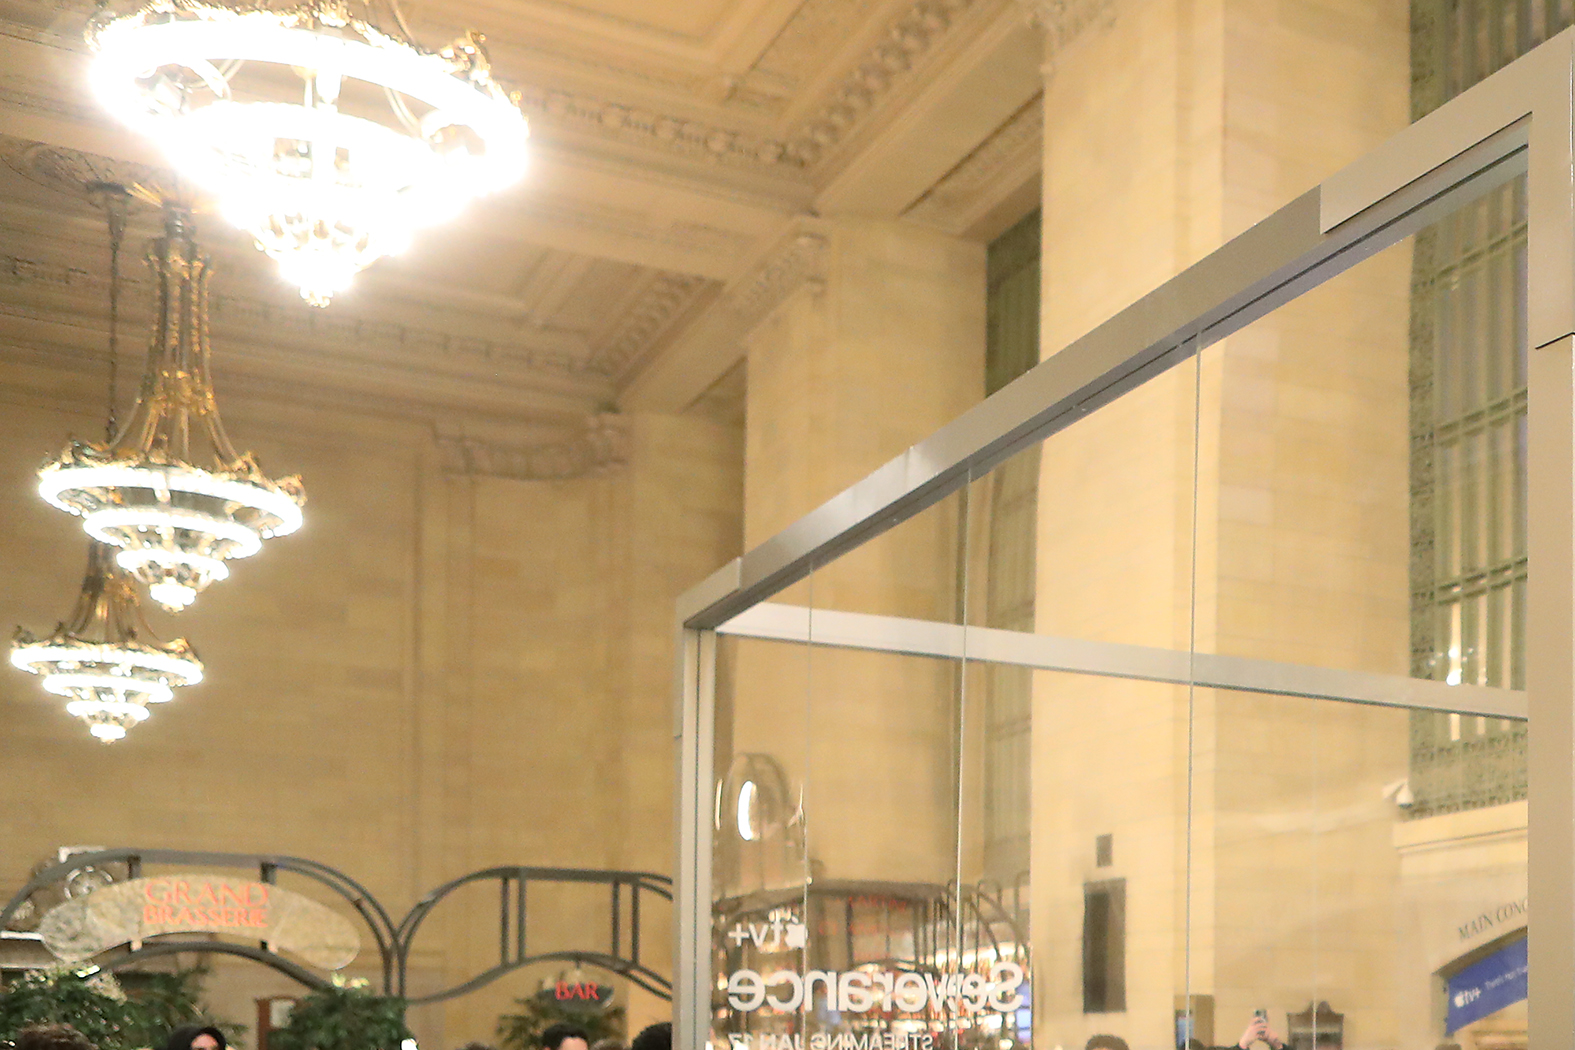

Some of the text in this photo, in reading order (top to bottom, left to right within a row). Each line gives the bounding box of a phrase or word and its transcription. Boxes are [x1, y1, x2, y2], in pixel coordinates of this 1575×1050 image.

[144, 879, 270, 908] GRAND
[143, 904, 269, 928] BRASSERIE
[1458, 913, 1494, 940] MAIN
[555, 980, 600, 1001] BAR
